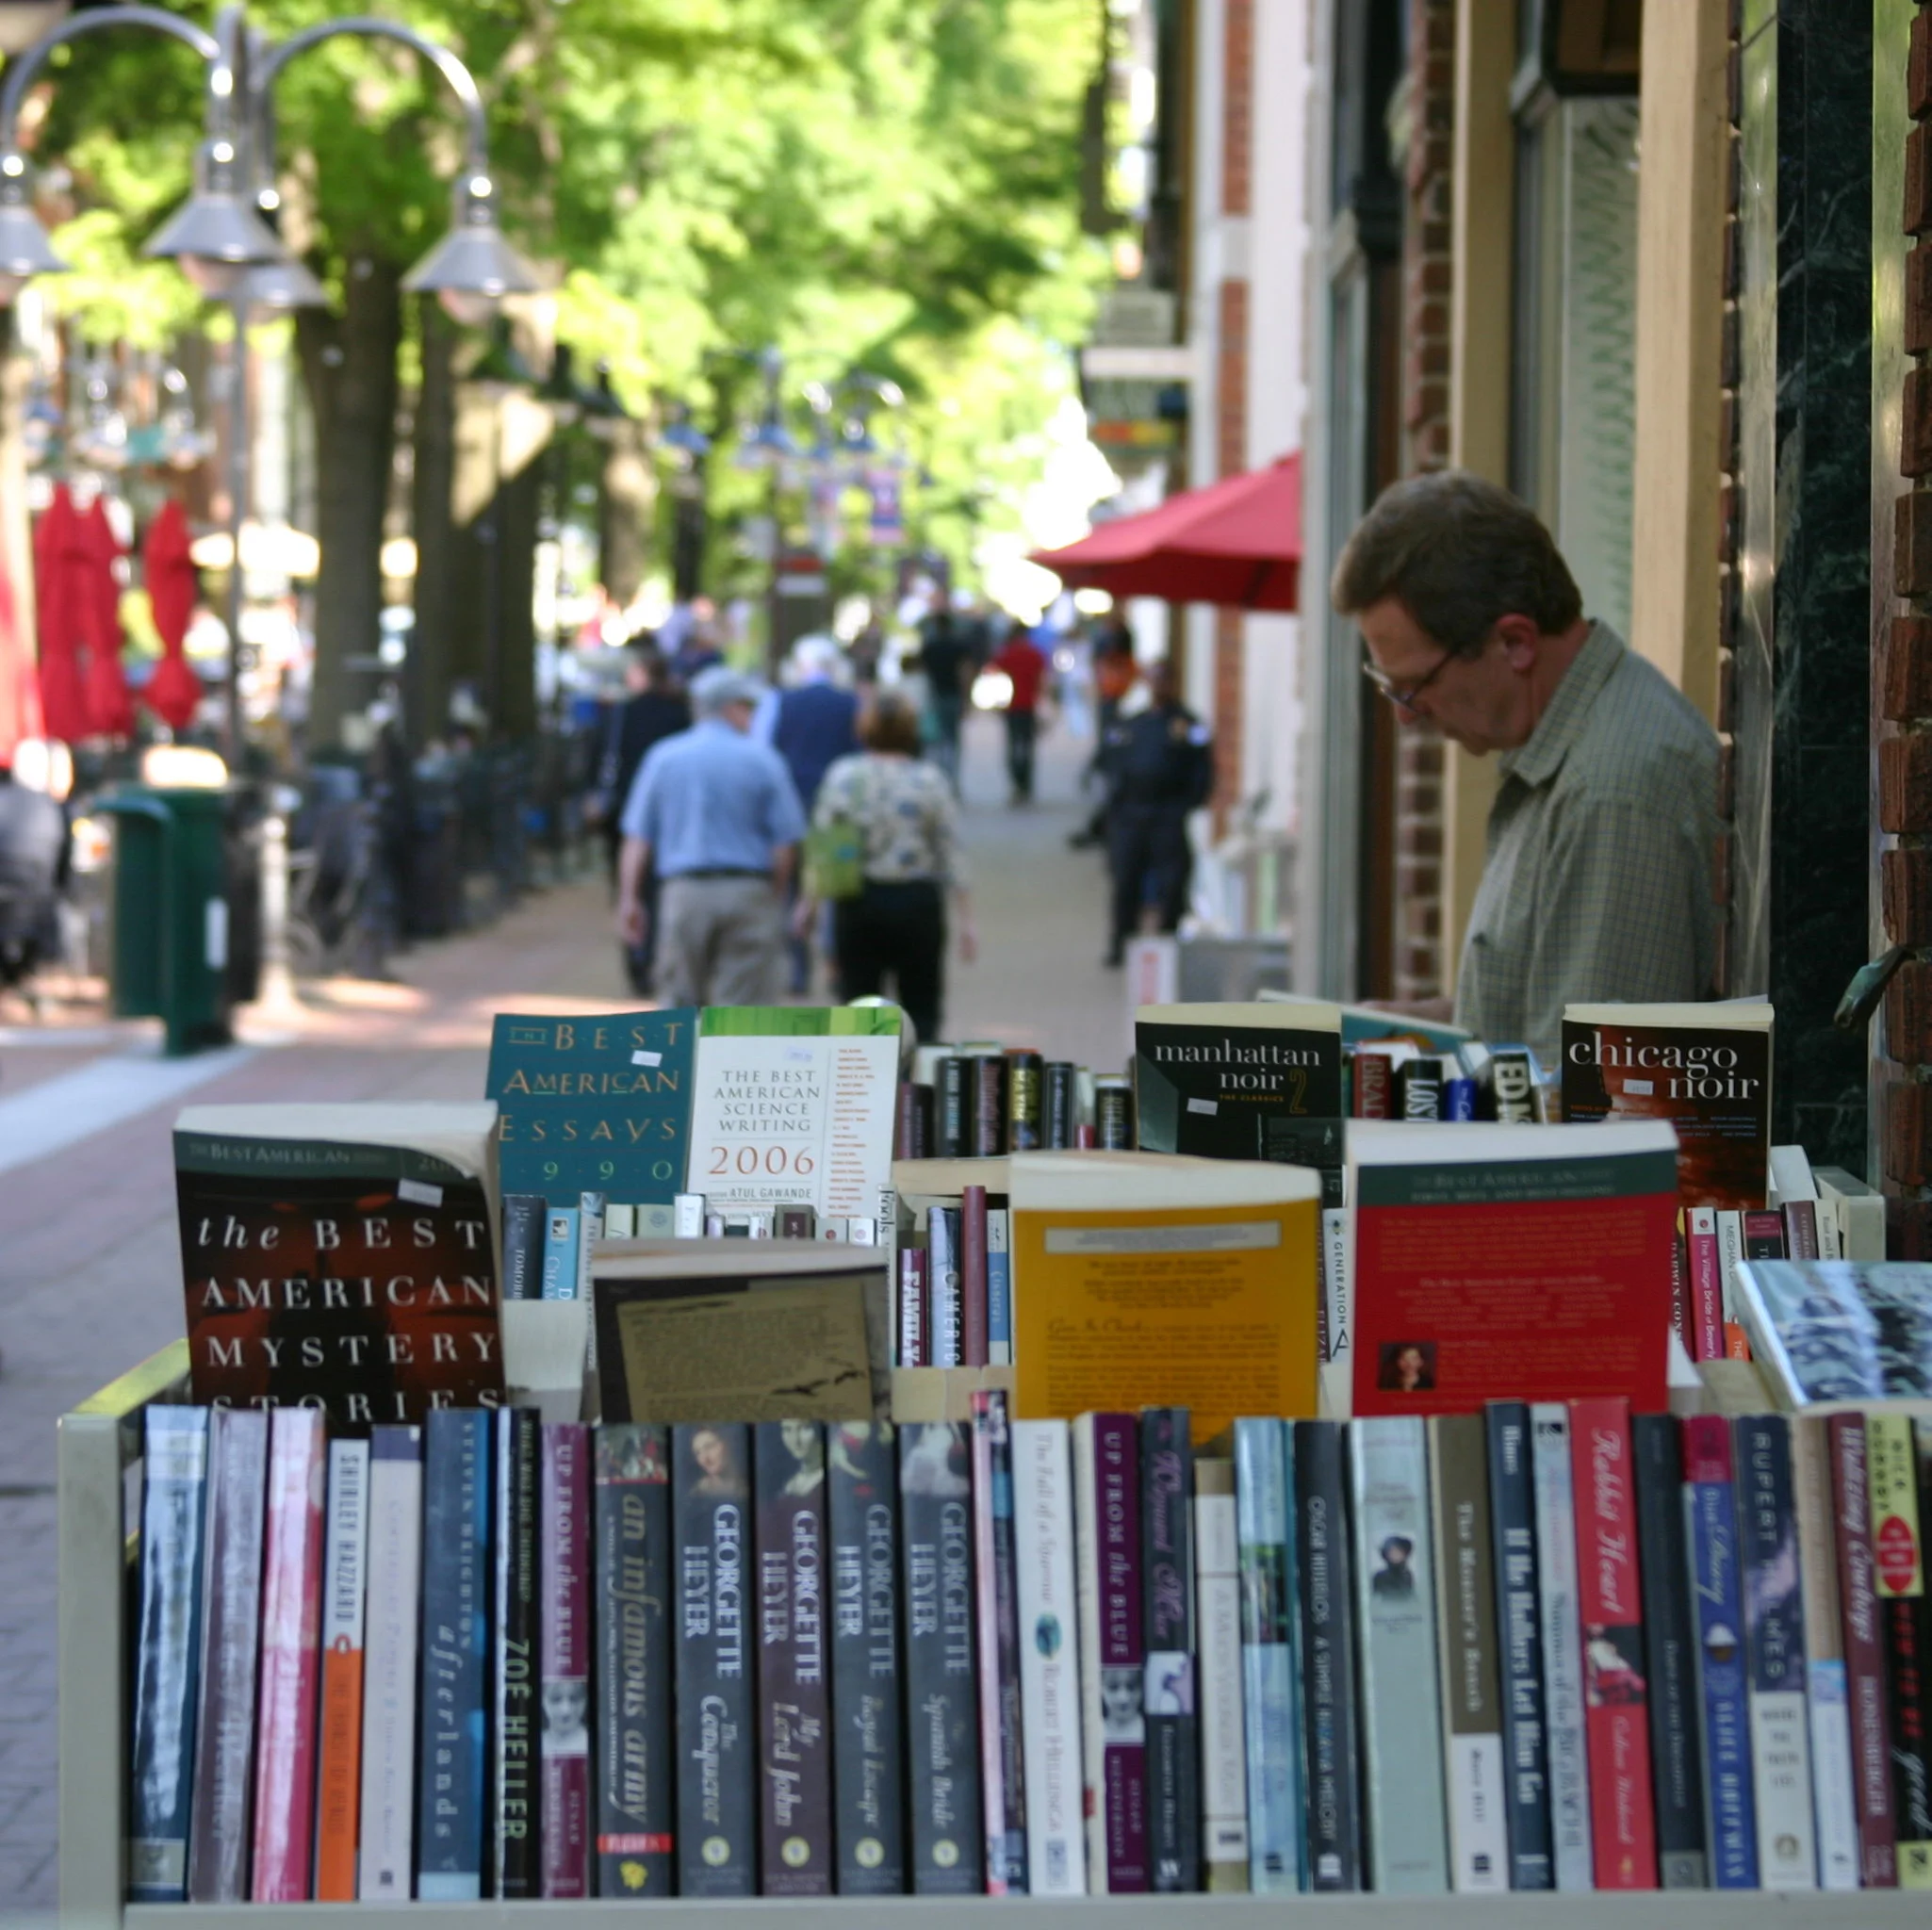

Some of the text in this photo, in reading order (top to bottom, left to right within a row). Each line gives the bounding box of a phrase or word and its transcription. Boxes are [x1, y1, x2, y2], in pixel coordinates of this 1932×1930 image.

[556, 1022, 684, 1051] BEST
[1154, 1038, 1322, 1067] manhattan
[1568, 1030, 1738, 1080] chicago
[501, 1069, 679, 1094] AMERICAN
[714, 1087, 821, 1099] AMERICAN
[723, 1070, 817, 1083] THE BEST
[1220, 1068, 1307, 1115] noir 2
[1494, 1061, 1529, 1100] ED
[1667, 1071, 1760, 1100] noir
[499, 1115, 677, 1144] ESSAYS
[719, 1119, 811, 1132] WRITING
[723, 1103, 810, 1116] SCIENCE
[708, 1145, 814, 1176] 2006
[730, 1187, 757, 1199] ATUL
[760, 1186, 812, 1199] GAWANDE
[198, 1215, 281, 1251] the
[314, 1217, 484, 1250] BEST
[1701, 1238, 1710, 1256] The
[1726, 1224, 1736, 1268] MEGHAN
[202, 1275, 491, 1309] AMERICAN
[1670, 1241, 1681, 1297] DARWIN
[1701, 1258, 1712, 1289] Village
[1332, 1241, 1350, 1358] GENERATION A
[1704, 1290, 1714, 1316] Bride
[207, 1332, 498, 1367] MYSTERY
[556, 1444, 573, 1477] UP
[1750, 1431, 1778, 1545] RUPERT
[336, 1453, 360, 1622] SHIRLEY HAZZARD
[556, 1486, 573, 1555] FROM
[623, 1494, 647, 1541] an
[1591, 1427, 1629, 1613] Rabbit Heart
[1104, 1431, 1132, 1659] UP FROM the BLUE
[683, 1546, 711, 1639] HEYER
[713, 1503, 742, 1680] GEORGETTE
[762, 1552, 788, 1644] HEYER
[792, 1510, 821, 1685] GEORGETTE
[836, 1545, 863, 1638] HEYER
[866, 1503, 894, 1677] GEORGETTE
[910, 1544, 937, 1637] HEYER
[942, 1501, 970, 1676] GEORGETTE
[607, 1554, 663, 1720] infamous
[1512, 1678, 1539, 1714] Let
[430, 1625, 463, 1840] afterlands
[797, 1714, 821, 1749] My
[504, 1715, 529, 1840] HELLER
[607, 1728, 649, 1824] army
[690, 1695, 729, 1826] Conqueror
[768, 1702, 801, 1827] Lord John
[1516, 1772, 1544, 1805] Go
